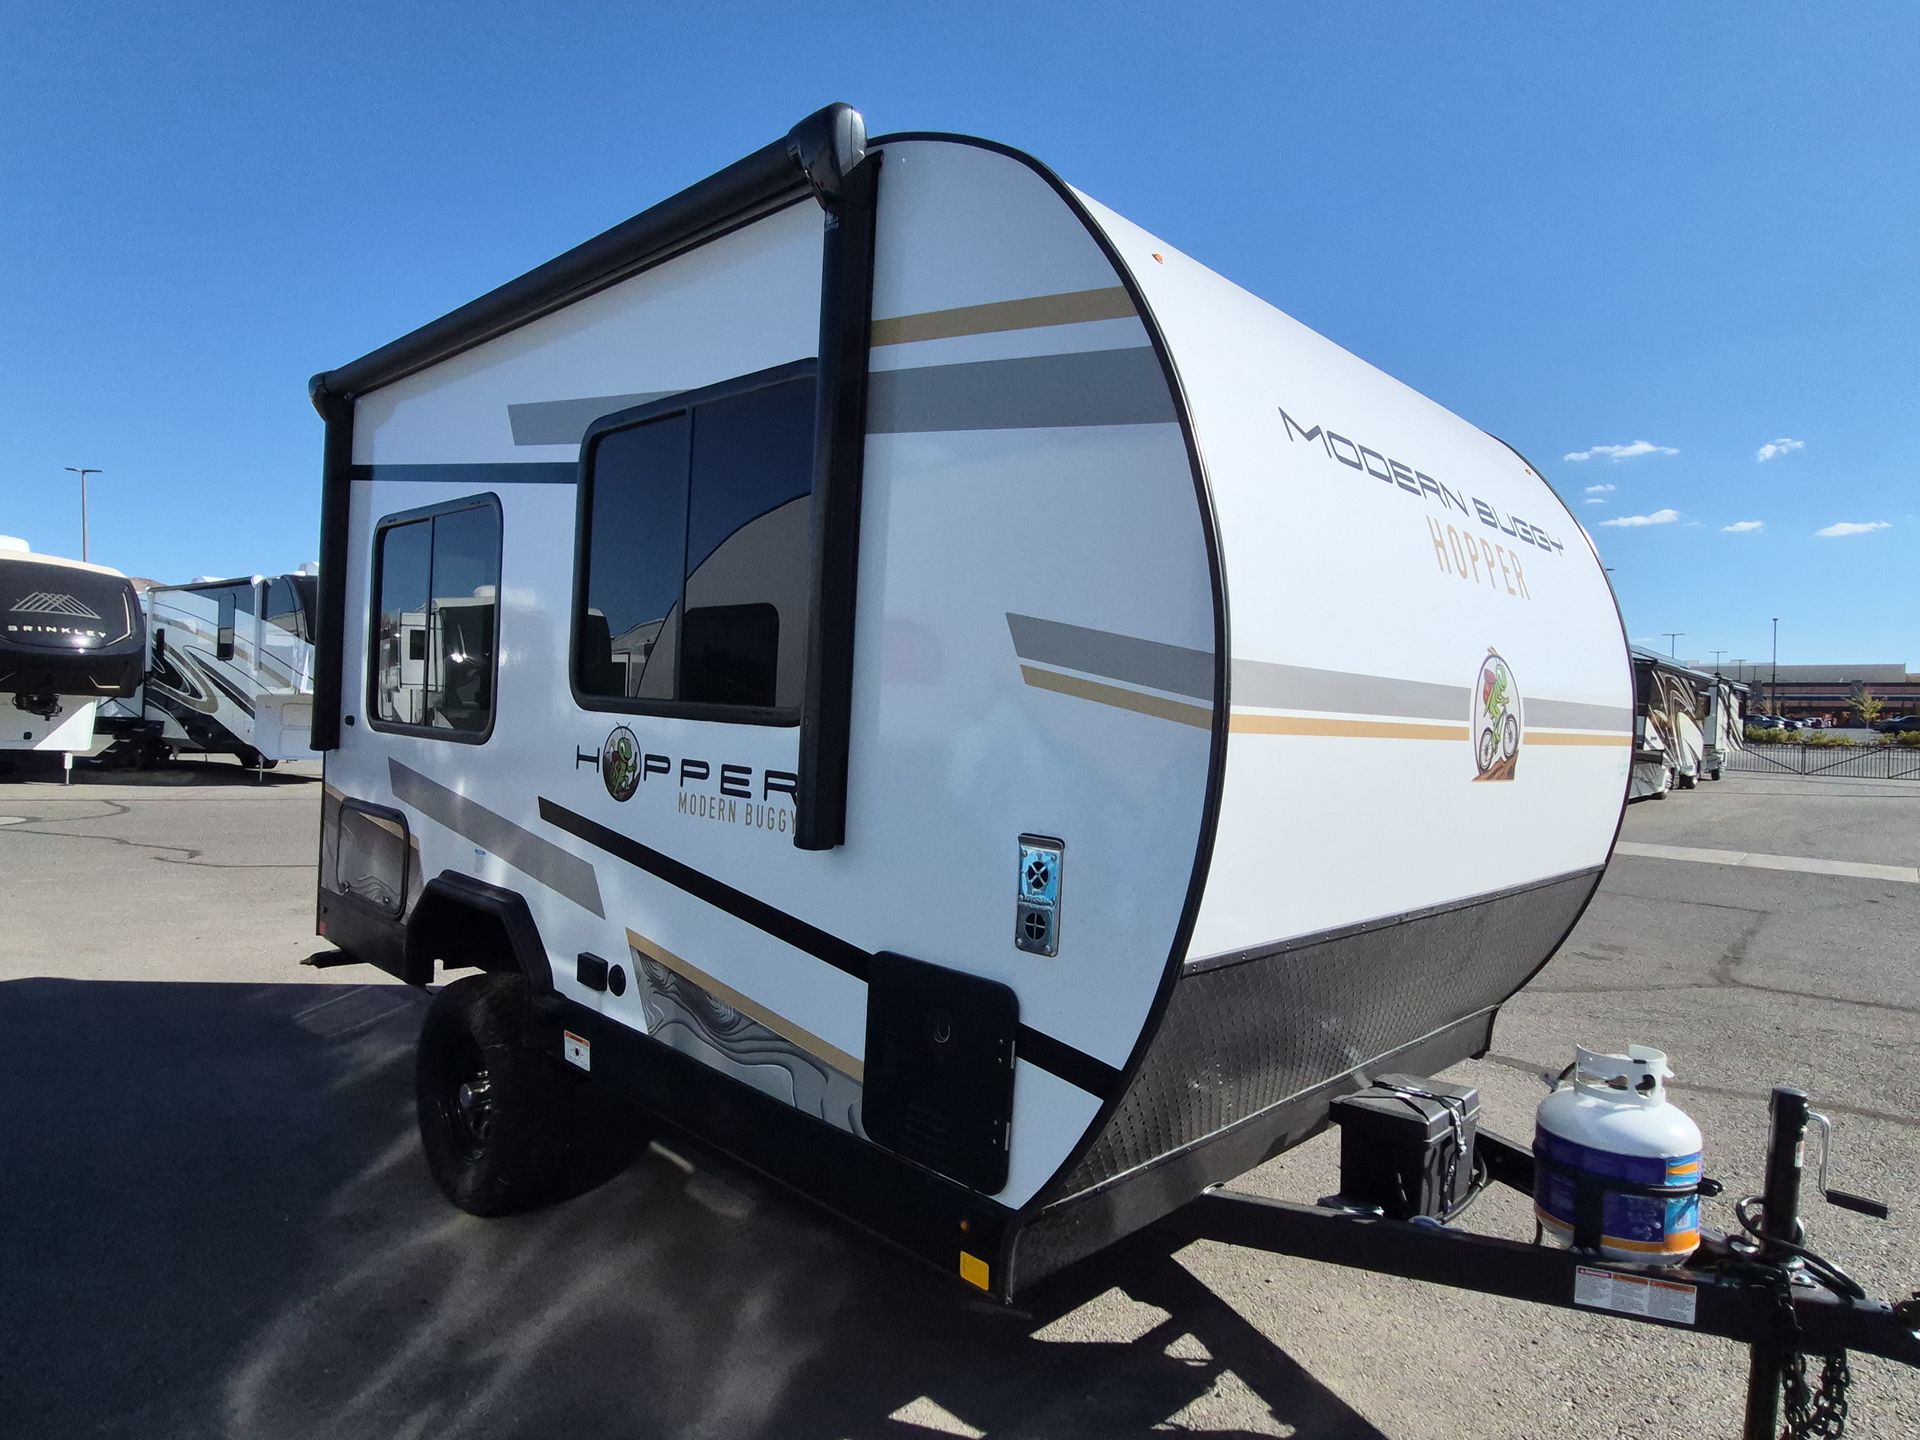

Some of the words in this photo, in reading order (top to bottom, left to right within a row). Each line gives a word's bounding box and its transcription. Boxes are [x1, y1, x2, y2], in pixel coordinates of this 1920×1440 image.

[1278, 406, 1469, 517] MODERN
[1471, 496, 1564, 557] BUGGY
[1425, 514, 1530, 600] HOPPER
[7, 625, 107, 638] BRINKLEY
[678, 792, 736, 823] MODERN
